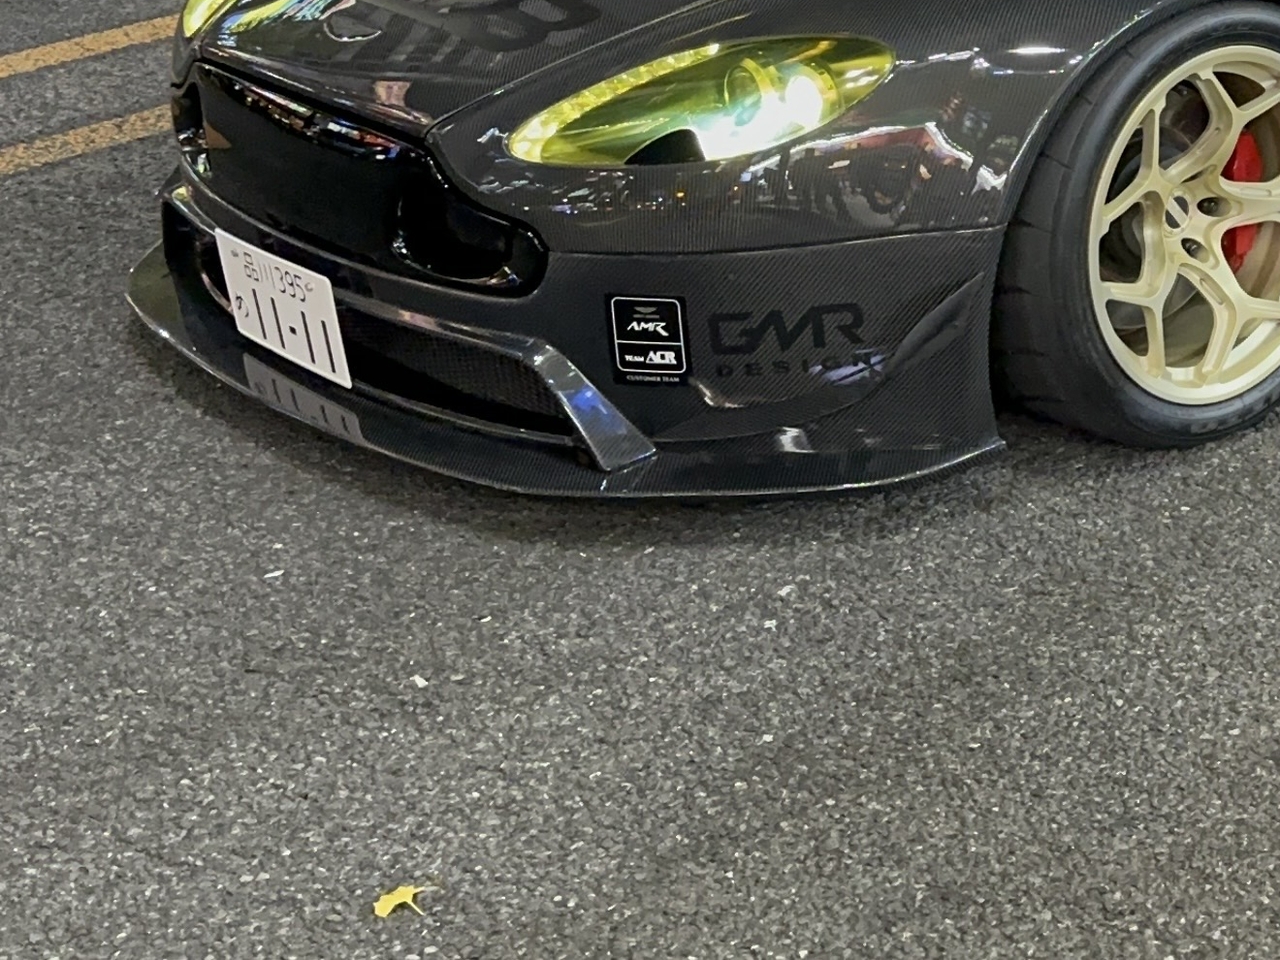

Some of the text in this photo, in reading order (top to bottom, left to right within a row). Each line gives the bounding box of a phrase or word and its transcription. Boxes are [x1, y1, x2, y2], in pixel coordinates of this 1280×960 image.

[243, 251, 307, 302] 品川 395
[627, 321, 669, 336] AMR
[707, 302, 866, 355] GMR
[624, 354, 645, 362] TEAM
[715, 350, 872, 378] DESIGN
